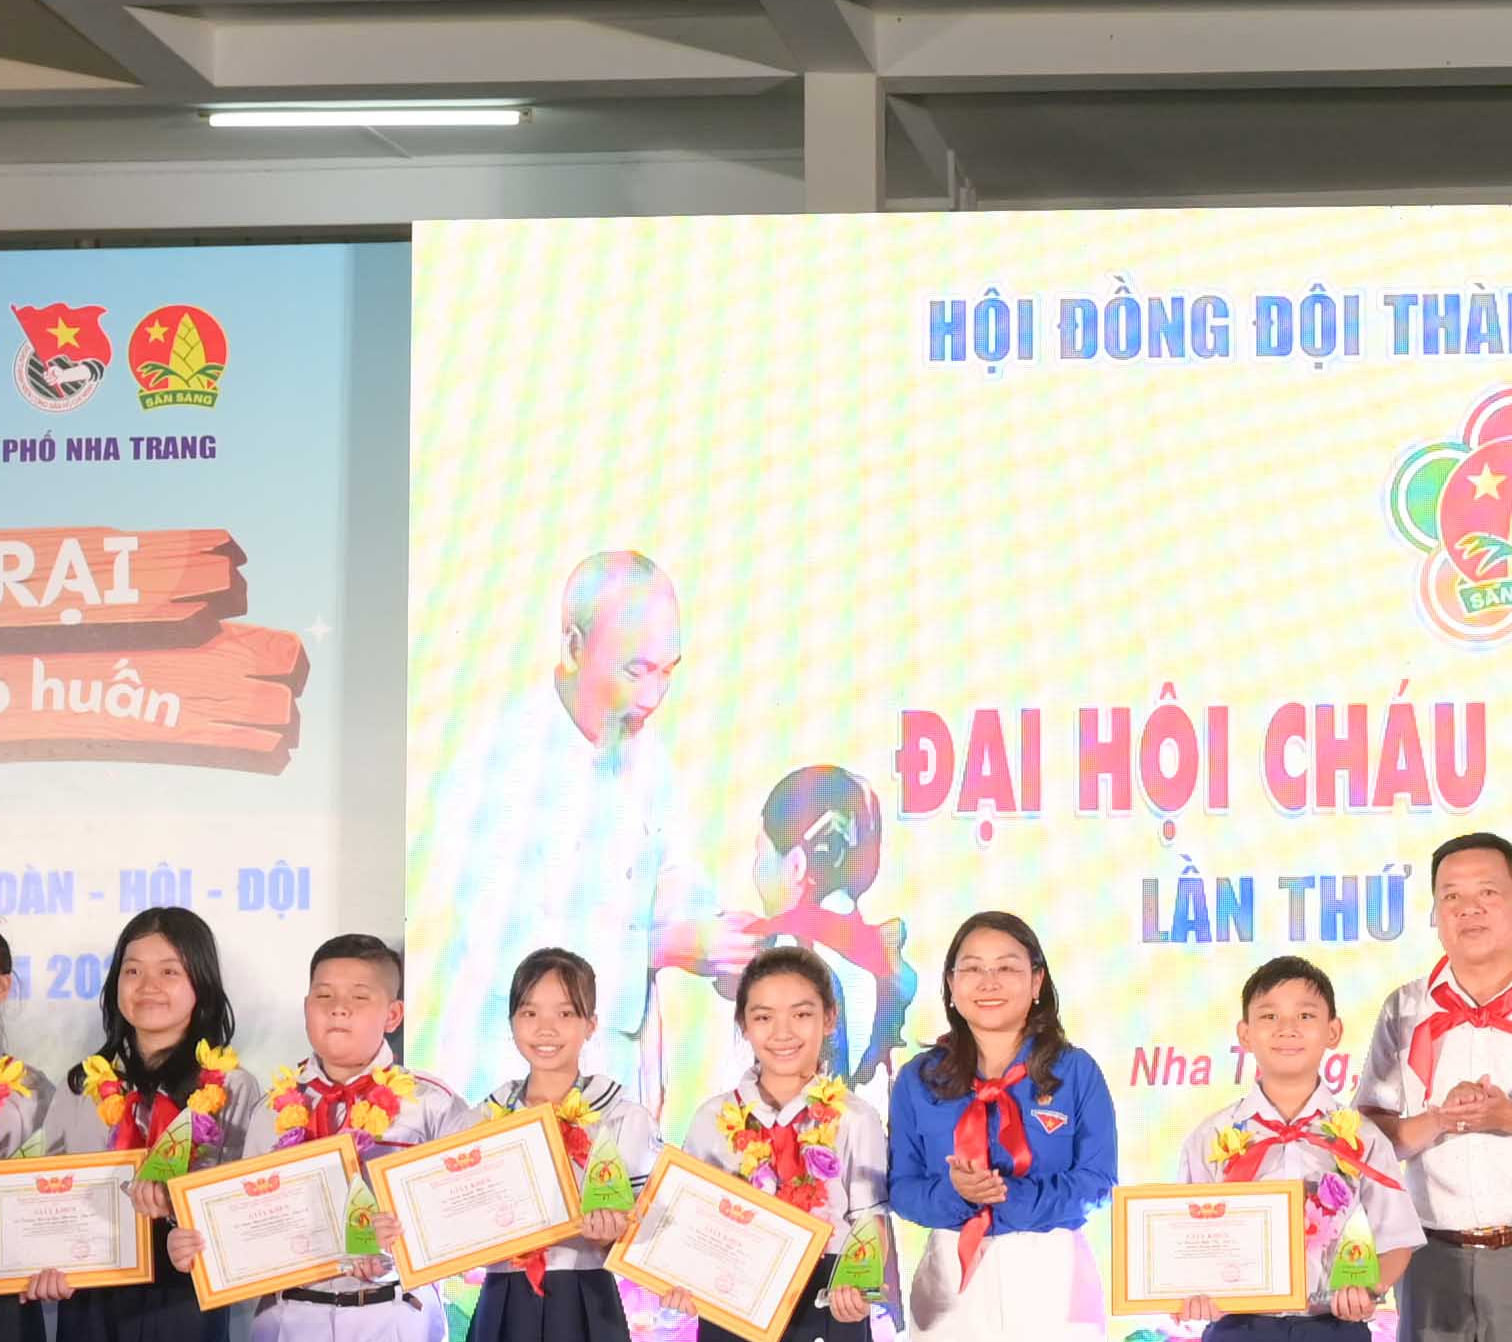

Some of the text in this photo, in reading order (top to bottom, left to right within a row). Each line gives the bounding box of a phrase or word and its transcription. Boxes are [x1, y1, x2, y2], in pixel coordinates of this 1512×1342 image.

[929, 283, 1036, 375] HỘI
[1058, 272, 1231, 362] ĐỒNG
[1253, 280, 1360, 374] ĐỘI
[2, 429, 56, 463] PHỐ
[67, 438, 119, 460] NHA
[129, 435, 216, 460] TRANG
[33, 659, 180, 728] huấn
[896, 699, 1043, 845] ĐẠI
[1076, 683, 1230, 844] HỘI
[1264, 678, 1488, 811] CHÁU
[237, 859, 311, 920] ĐỘI
[1141, 854, 1255, 944] LẦN
[1277, 862, 1411, 943] THỨ
[1129, 1046, 1212, 1085] Nha
